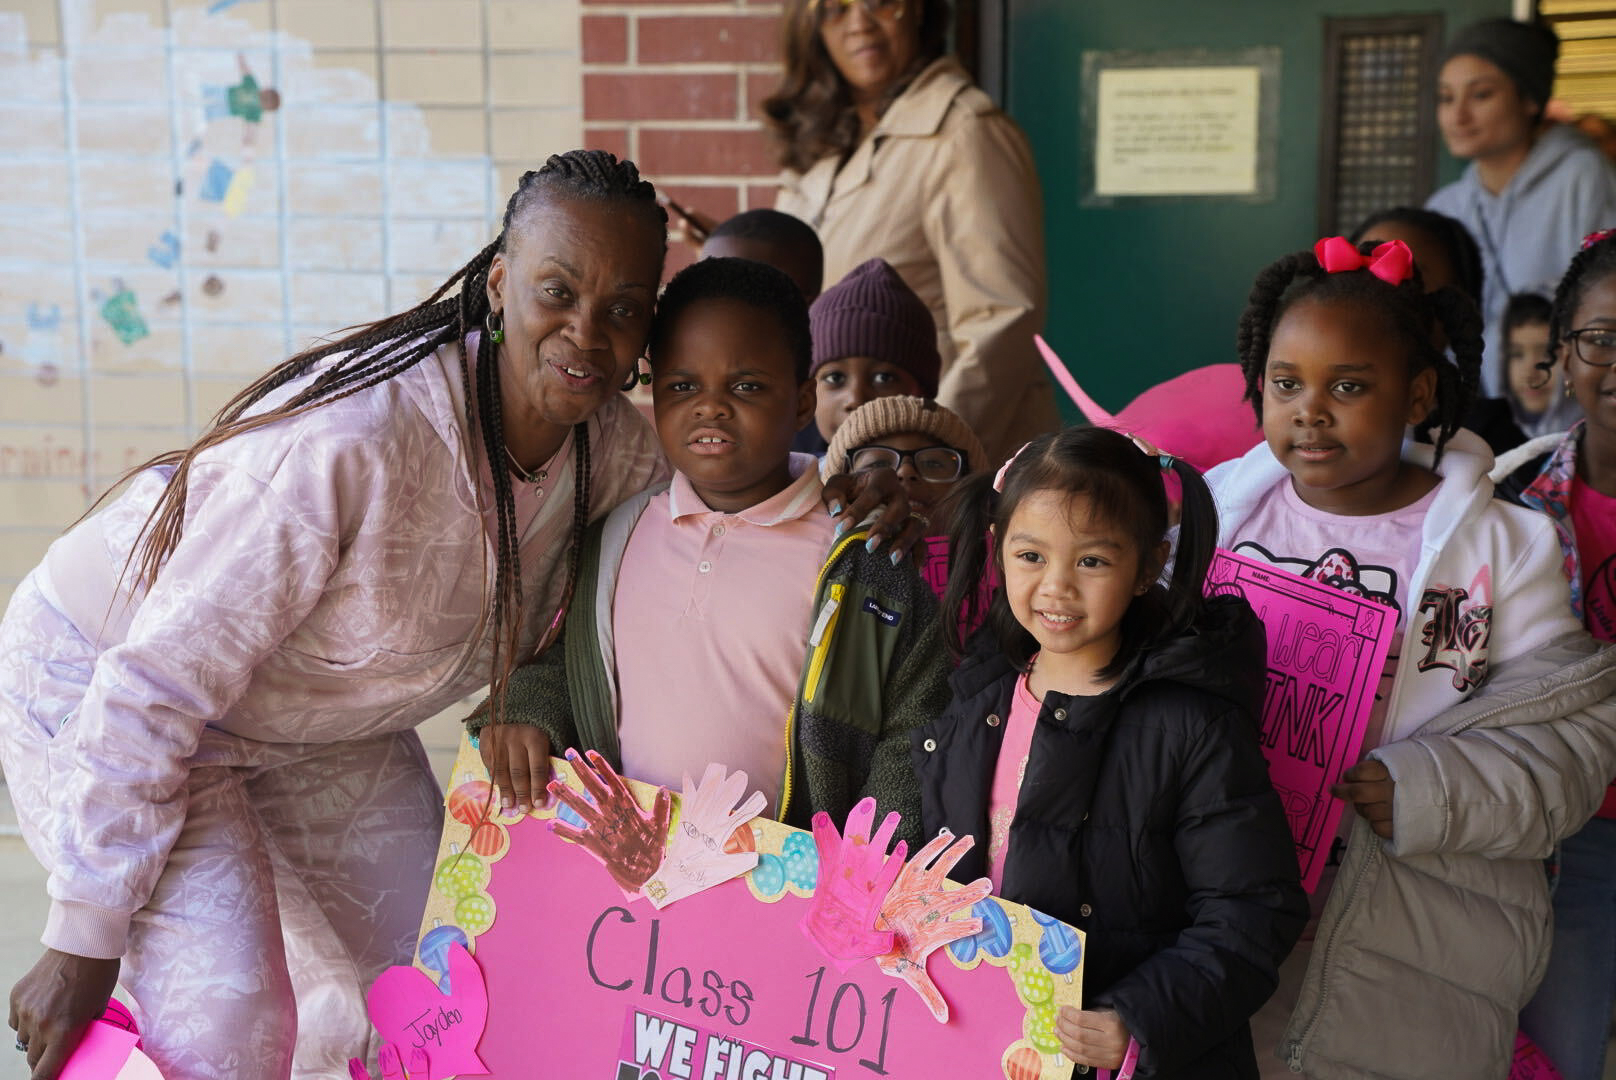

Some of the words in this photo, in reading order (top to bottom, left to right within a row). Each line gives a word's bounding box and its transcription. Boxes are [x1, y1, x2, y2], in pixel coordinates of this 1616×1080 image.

[1258, 668, 1345, 769] INK
[586, 905, 756, 1026] Class
[790, 966, 898, 1075] 101
[633, 1010, 699, 1080] WE
[702, 1032, 829, 1080] FIG
